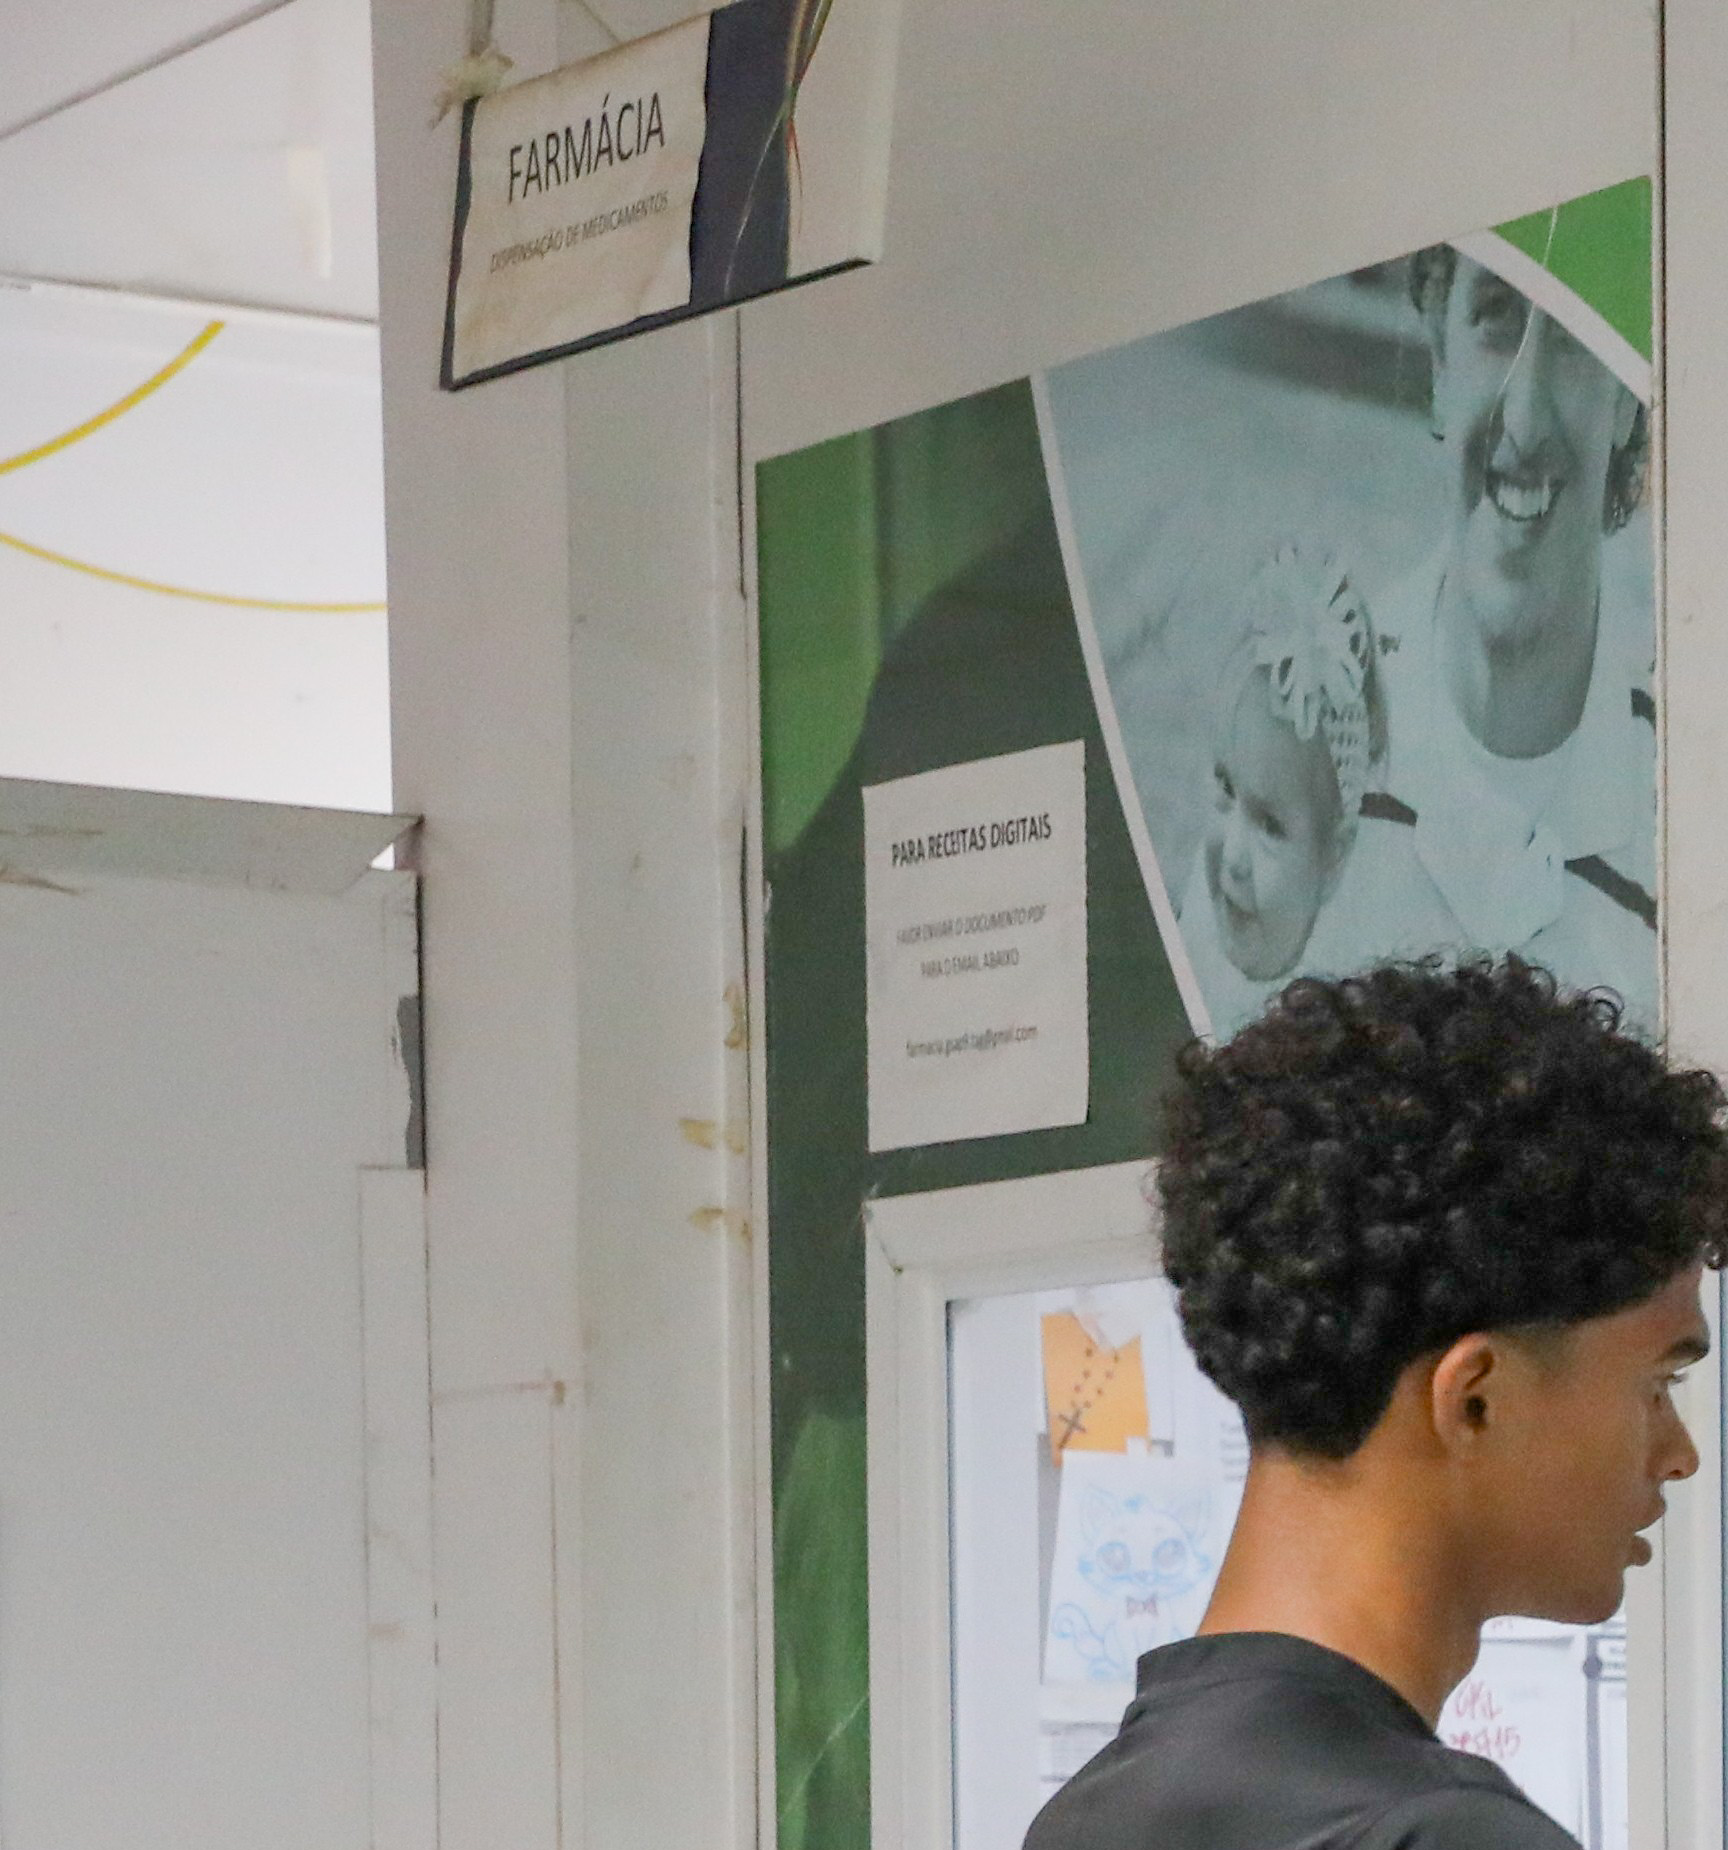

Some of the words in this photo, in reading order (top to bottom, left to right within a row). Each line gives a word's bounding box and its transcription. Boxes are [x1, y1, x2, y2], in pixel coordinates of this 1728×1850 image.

[508, 92, 666, 204] FARMÁCIA
[490, 228, 563, 273] DISPENSAÇÃO
[566, 223, 580, 248] DE
[582, 190, 669, 242] MEDICAMENTOS
[892, 839, 925, 868] PARA
[928, 825, 987, 860] RECEITAS
[991, 813, 1052, 849] DIGITAIS
